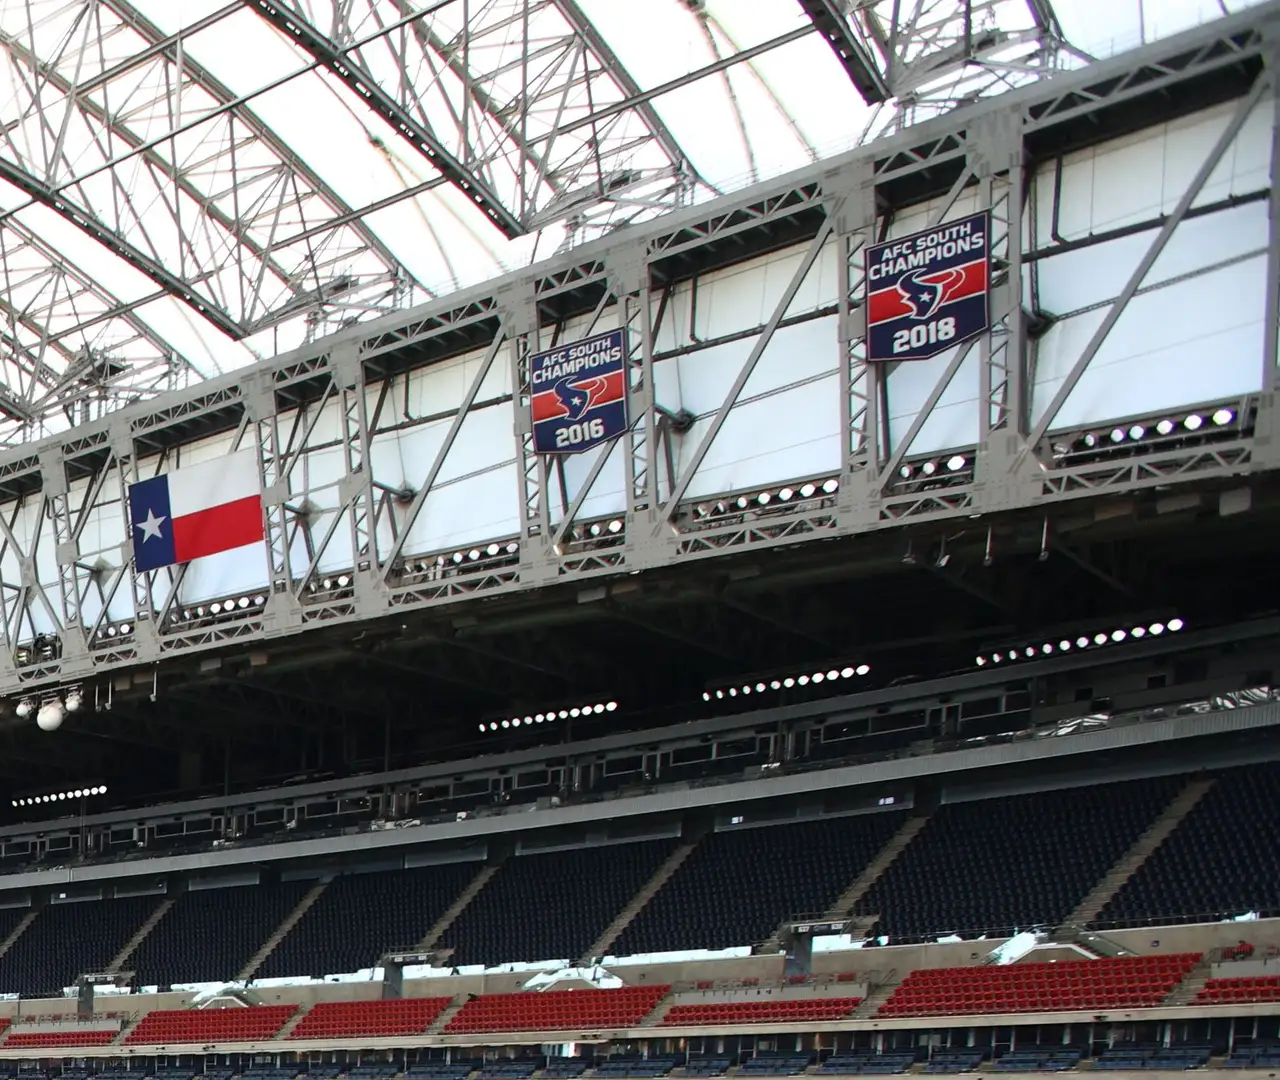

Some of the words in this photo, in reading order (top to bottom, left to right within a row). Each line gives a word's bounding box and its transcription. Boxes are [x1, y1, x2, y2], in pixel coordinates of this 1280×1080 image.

[868, 231, 985, 280] CHAMPIONS
[880, 239, 911, 262] AFC
[914, 223, 972, 254] SOUTH
[541, 348, 565, 367] AFC
[568, 338, 612, 362] SOUTH
[892, 317, 956, 354] 2018
[531, 345, 621, 384] CHAMPIONS
[554, 418, 604, 448] 2016
